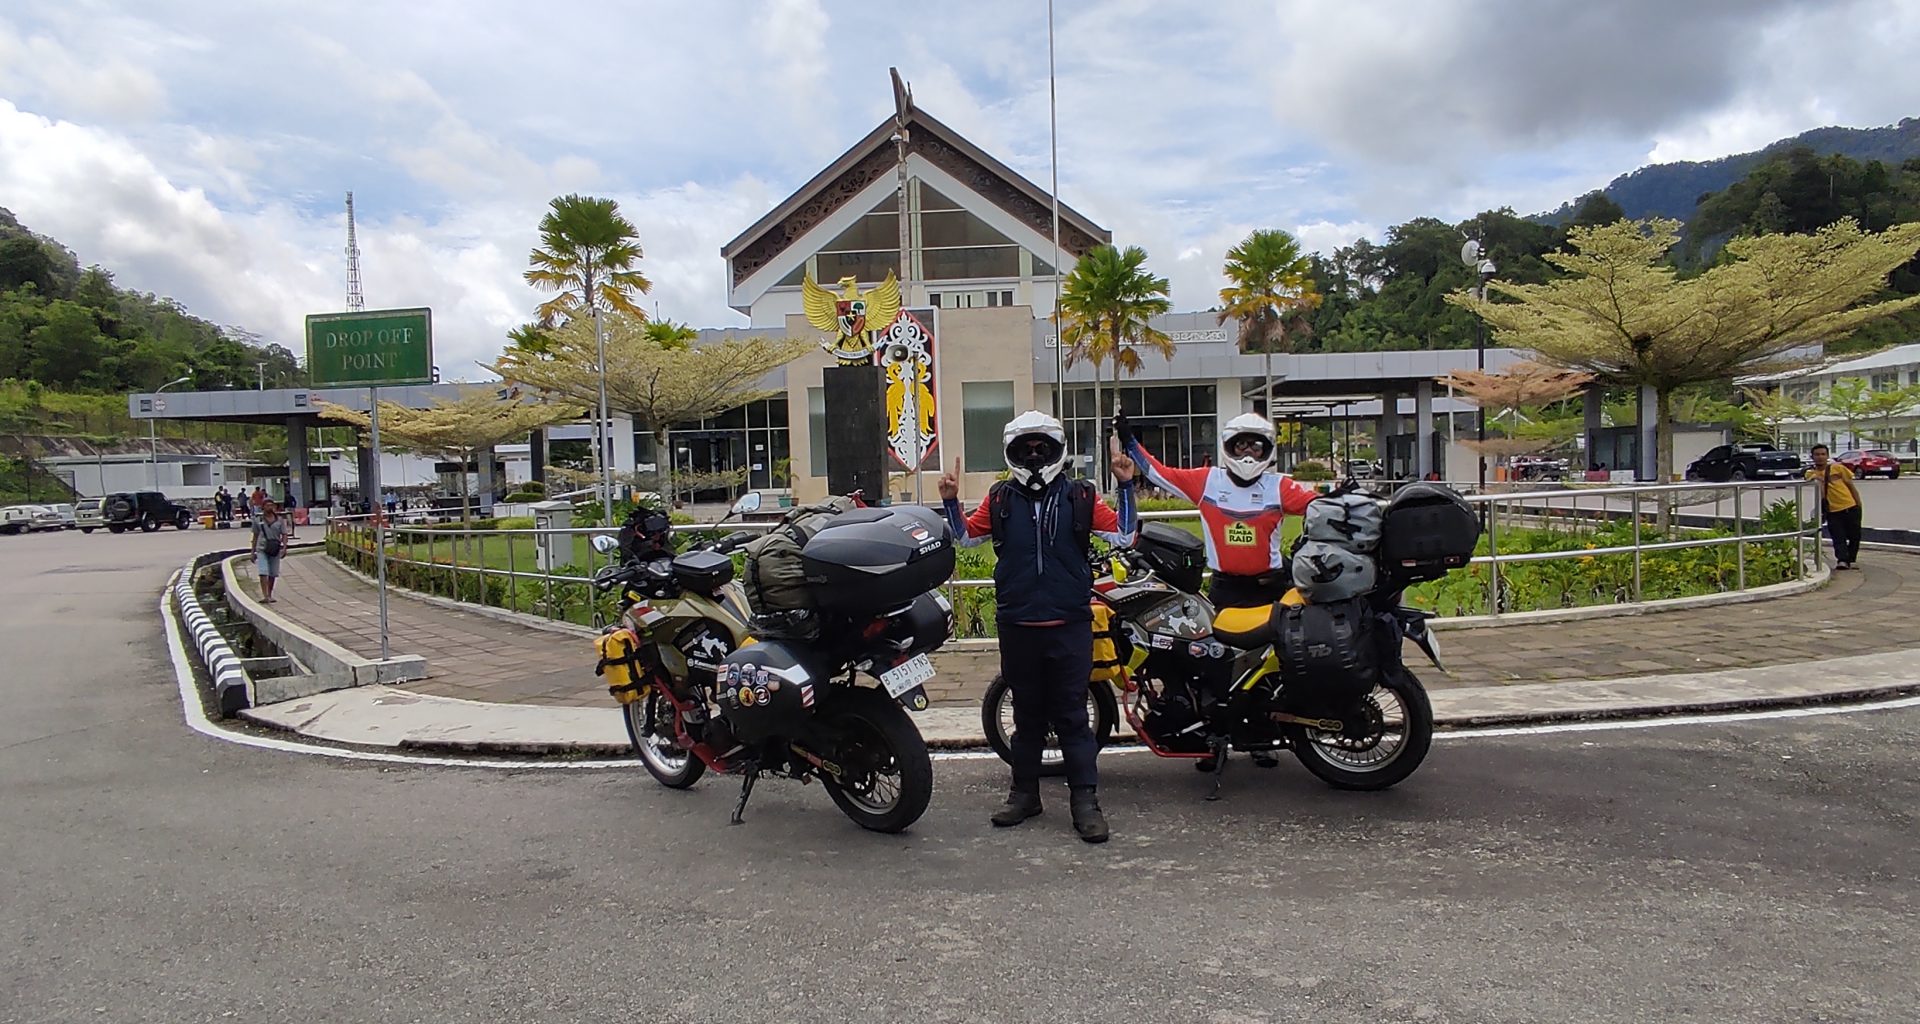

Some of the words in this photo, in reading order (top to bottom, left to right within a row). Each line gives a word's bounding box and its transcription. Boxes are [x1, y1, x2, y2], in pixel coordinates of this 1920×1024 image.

[326, 330, 373, 348] DROP
[378, 328, 414, 345] OFF
[343, 352, 398, 370] POINT
[919, 541, 942, 555] SHAD
[1229, 535, 1253, 543] RAID
[882, 675, 891, 686] B
[891, 663, 912, 680] 5151
[912, 654, 928, 670] FNS
